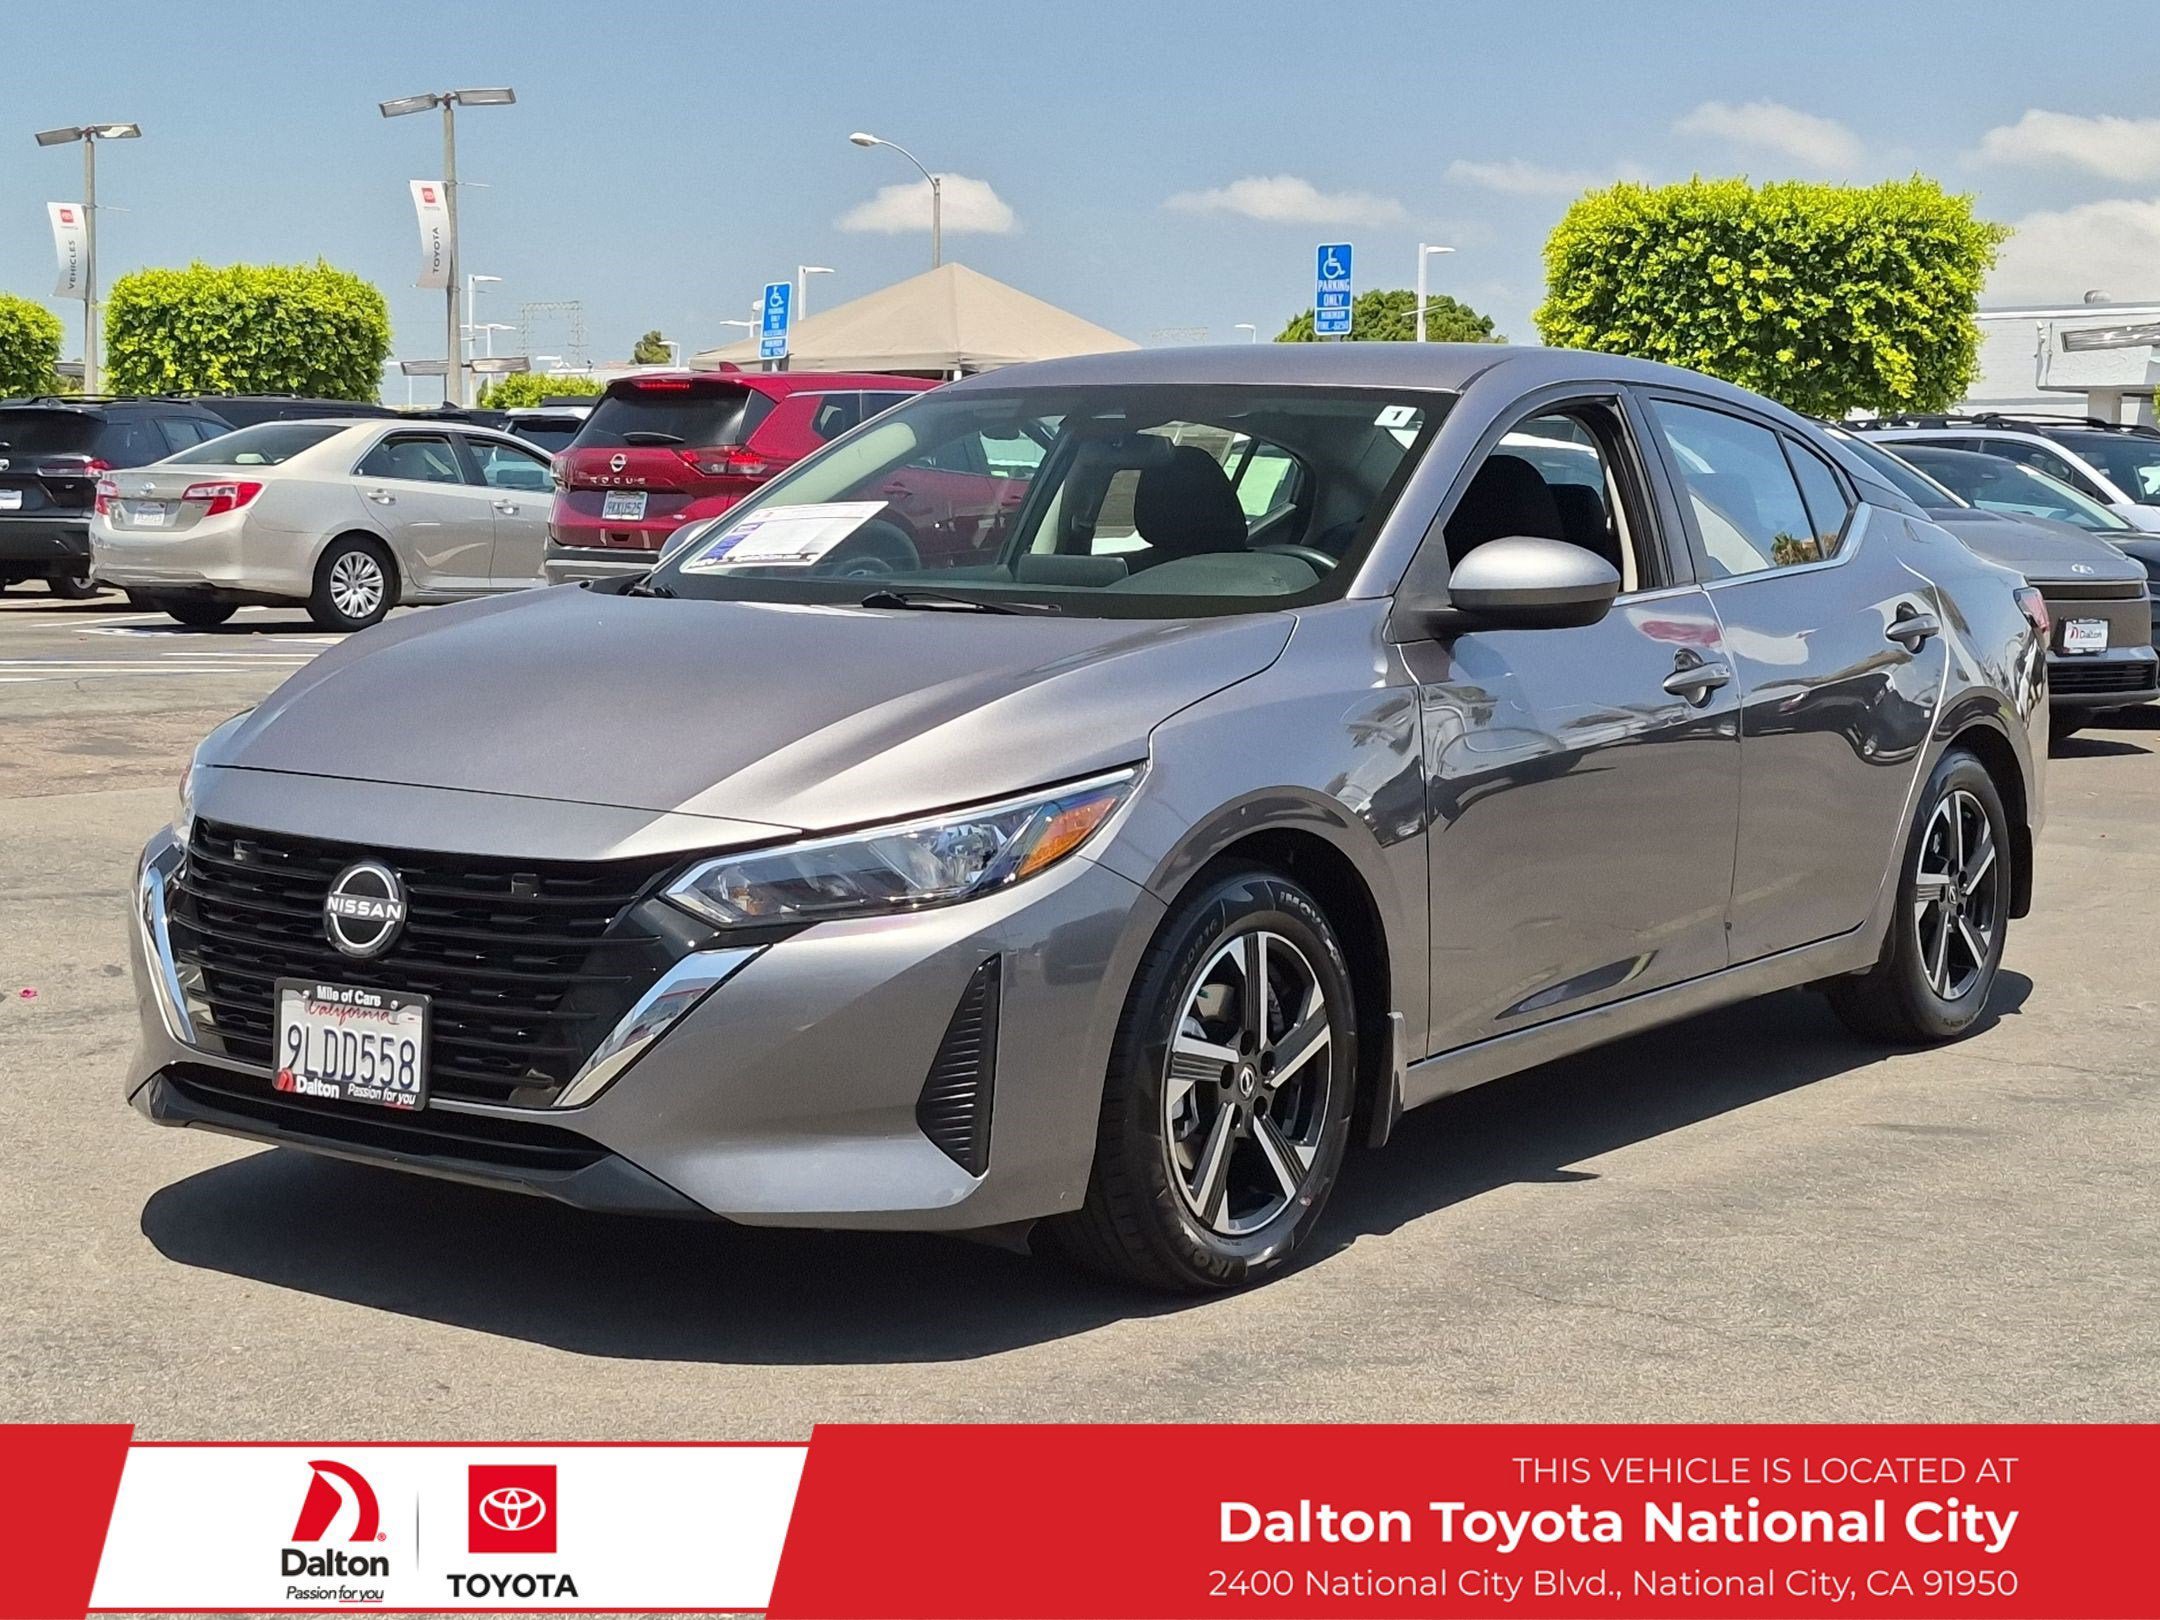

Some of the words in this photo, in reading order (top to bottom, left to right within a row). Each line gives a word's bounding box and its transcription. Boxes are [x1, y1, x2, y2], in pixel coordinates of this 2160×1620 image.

[433, 227, 441, 274] TOYOTA
[68, 240, 77, 290] VEHICLES
[1318, 279, 1350, 292] PARKING
[1323, 293, 1344, 306] ONLY
[327, 896, 402, 919] NISSAN
[317, 985, 339, 1001] Mile
[341, 989, 354, 1003] of
[355, 990, 382, 1007] Cars
[308, 999, 400, 1026] California
[287, 1024, 416, 1089] 9LDD558
[296, 1075, 340, 1099] Dalton
[347, 1082, 382, 1100] Passion
[382, 1087, 398, 1102] for
[397, 1092, 416, 1105] you
